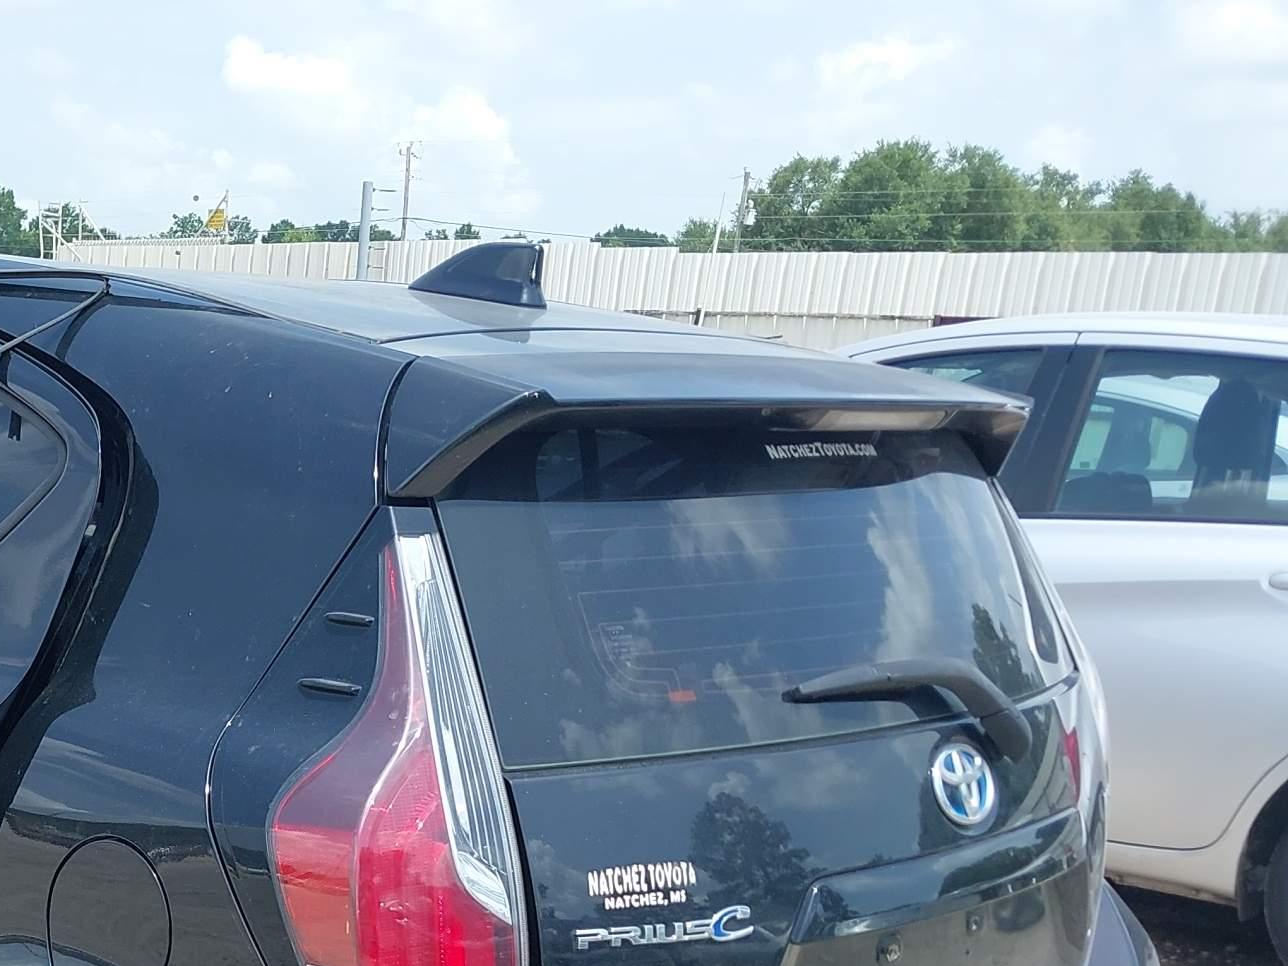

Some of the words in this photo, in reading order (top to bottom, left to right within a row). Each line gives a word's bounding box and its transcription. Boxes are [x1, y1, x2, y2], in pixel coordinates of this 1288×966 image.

[588, 863, 647, 896] NATCHEZ
[647, 861, 697, 887] TOYOTA
[604, 892, 668, 911] NATCHEZ,
[669, 889, 687, 904] MS
[574, 918, 713, 950] PRIUS
